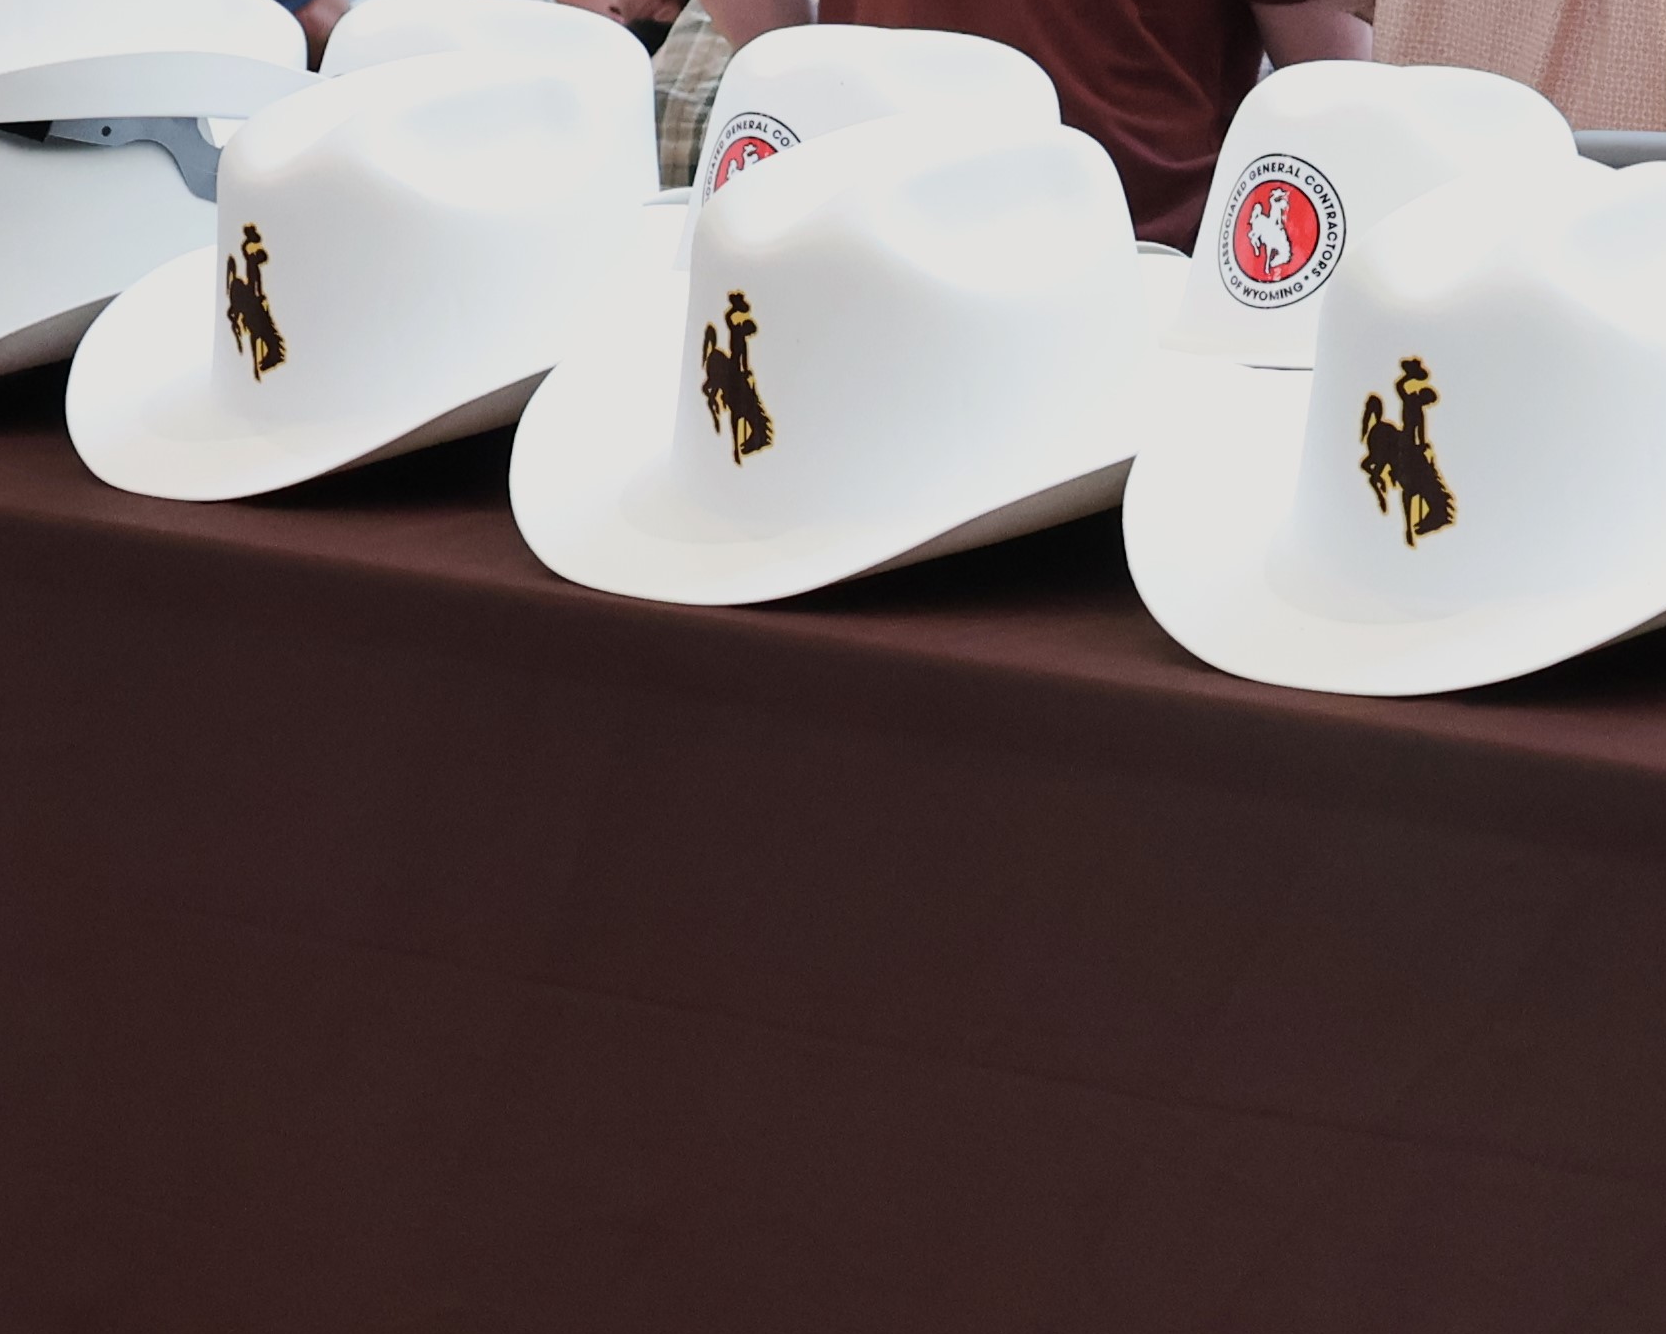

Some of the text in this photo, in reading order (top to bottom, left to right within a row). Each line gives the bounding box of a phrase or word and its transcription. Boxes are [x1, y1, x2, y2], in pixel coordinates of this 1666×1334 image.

[725, 120, 768, 140] GENERAL
[1222, 162, 1338, 278] ASSOCIATED GENERAL CONTRACTORS
[1230, 275, 1304, 301] OF WYOMING
